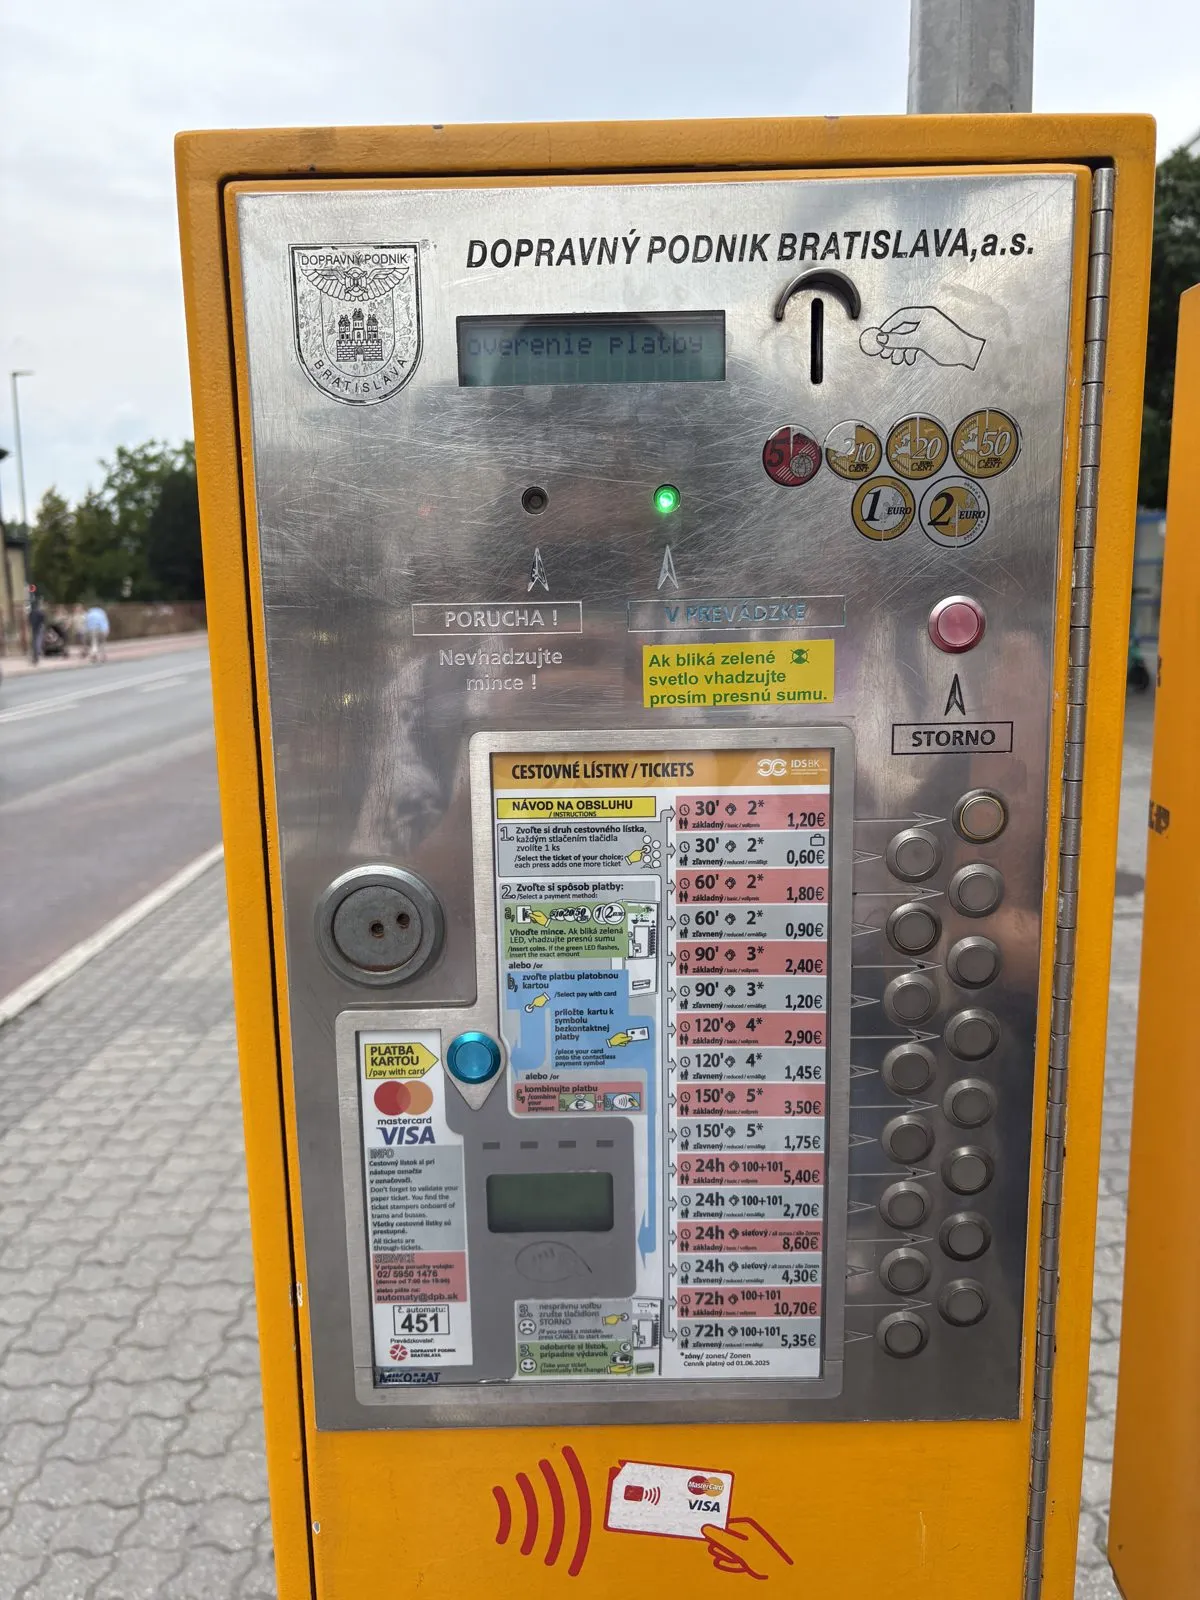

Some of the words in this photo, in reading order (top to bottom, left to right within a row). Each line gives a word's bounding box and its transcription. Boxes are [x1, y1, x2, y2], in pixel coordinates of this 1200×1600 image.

[467, 229, 640, 268] DOPRAVNÝ
[647, 232, 770, 265] PODNIK
[777, 228, 1034, 262] BRATISLAVA,a.s.
[365, 253, 408, 264] PODNIK
[468, 331, 593, 356] overenie
[609, 331, 703, 356] platby
[314, 358, 408, 393] BRATISLAVA
[911, 436, 942, 460] 20
[978, 431, 1011, 456] 50
[854, 442, 876, 463] 10
[862, 489, 882, 522] 1
[887, 506, 912, 515] EURO
[928, 492, 955, 526] 2
[959, 510, 986, 519] EURO
[444, 611, 544, 628] PORUCHA
[552, 611, 558, 626] !
[664, 606, 681, 625] V
[685, 601, 807, 624] PREVÁDZKE
[439, 648, 563, 669] Nevhadzujte
[648, 653, 671, 668] Ak
[676, 651, 716, 667] bliká
[721, 650, 775, 665] zelené
[466, 674, 523, 691] mince
[530, 673, 536, 690] !
[649, 671, 699, 686] svetlo
[704, 669, 786, 687] vhadzujte
[650, 689, 707, 707] prosím
[712, 688, 771, 706] presnú
[776, 689, 827, 702] sumu.
[912, 729, 996, 747] STORNO
[512, 761, 580, 779] CESTOVNÉ
[584, 761, 628, 778] LÍSTKY
[640, 762, 694, 778] TICKETS
[512, 799, 554, 811] NÁVOD
[557, 801, 573, 810] NA
[576, 800, 633, 810] OBSLUHU
[787, 812, 826, 829] 1,20€
[623, 825, 647, 834] lístka,
[516, 835, 546, 844] každým
[589, 834, 618, 842] tlačidla
[786, 850, 825, 867] 0,60€
[517, 883, 545, 892] Zvoľte
[548, 883, 555, 891] si
[557, 883, 589, 892] spôsob
[592, 883, 623, 892] platby:
[786, 886, 824, 903] 1,80€
[785, 958, 824, 976] 2,40€
[550, 973, 575, 981] platbu
[555, 1009, 584, 1017] priložte
[555, 1017, 588, 1025] symbolu
[555, 1025, 610, 1033] bezkontaktnej
[555, 1033, 579, 1042] platby
[784, 1030, 822, 1046] 2,90€
[370, 1046, 414, 1055] PLATBA
[370, 1056, 419, 1066] KARTOU
[369, 1068, 386, 1077] /pay
[784, 1100, 822, 1117] 3,50€
[378, 1116, 432, 1125] mastercard
[376, 1126, 435, 1145] VISA
[695, 1158, 724, 1172] 24h
[742, 1161, 783, 1172] 100+101
[784, 1170, 820, 1186] 5,40€
[695, 1258, 724, 1272] 24h
[782, 1270, 818, 1284] 4,30€
[401, 1313, 439, 1332] 451
[694, 1324, 724, 1338] 72h
[740, 1326, 780, 1337] 100+101
[780, 1334, 816, 1348] 5,35€
[706, 1360, 725, 1368] platný
[688, 1481, 724, 1491] MasterCard
[689, 1499, 720, 1513] VISA
